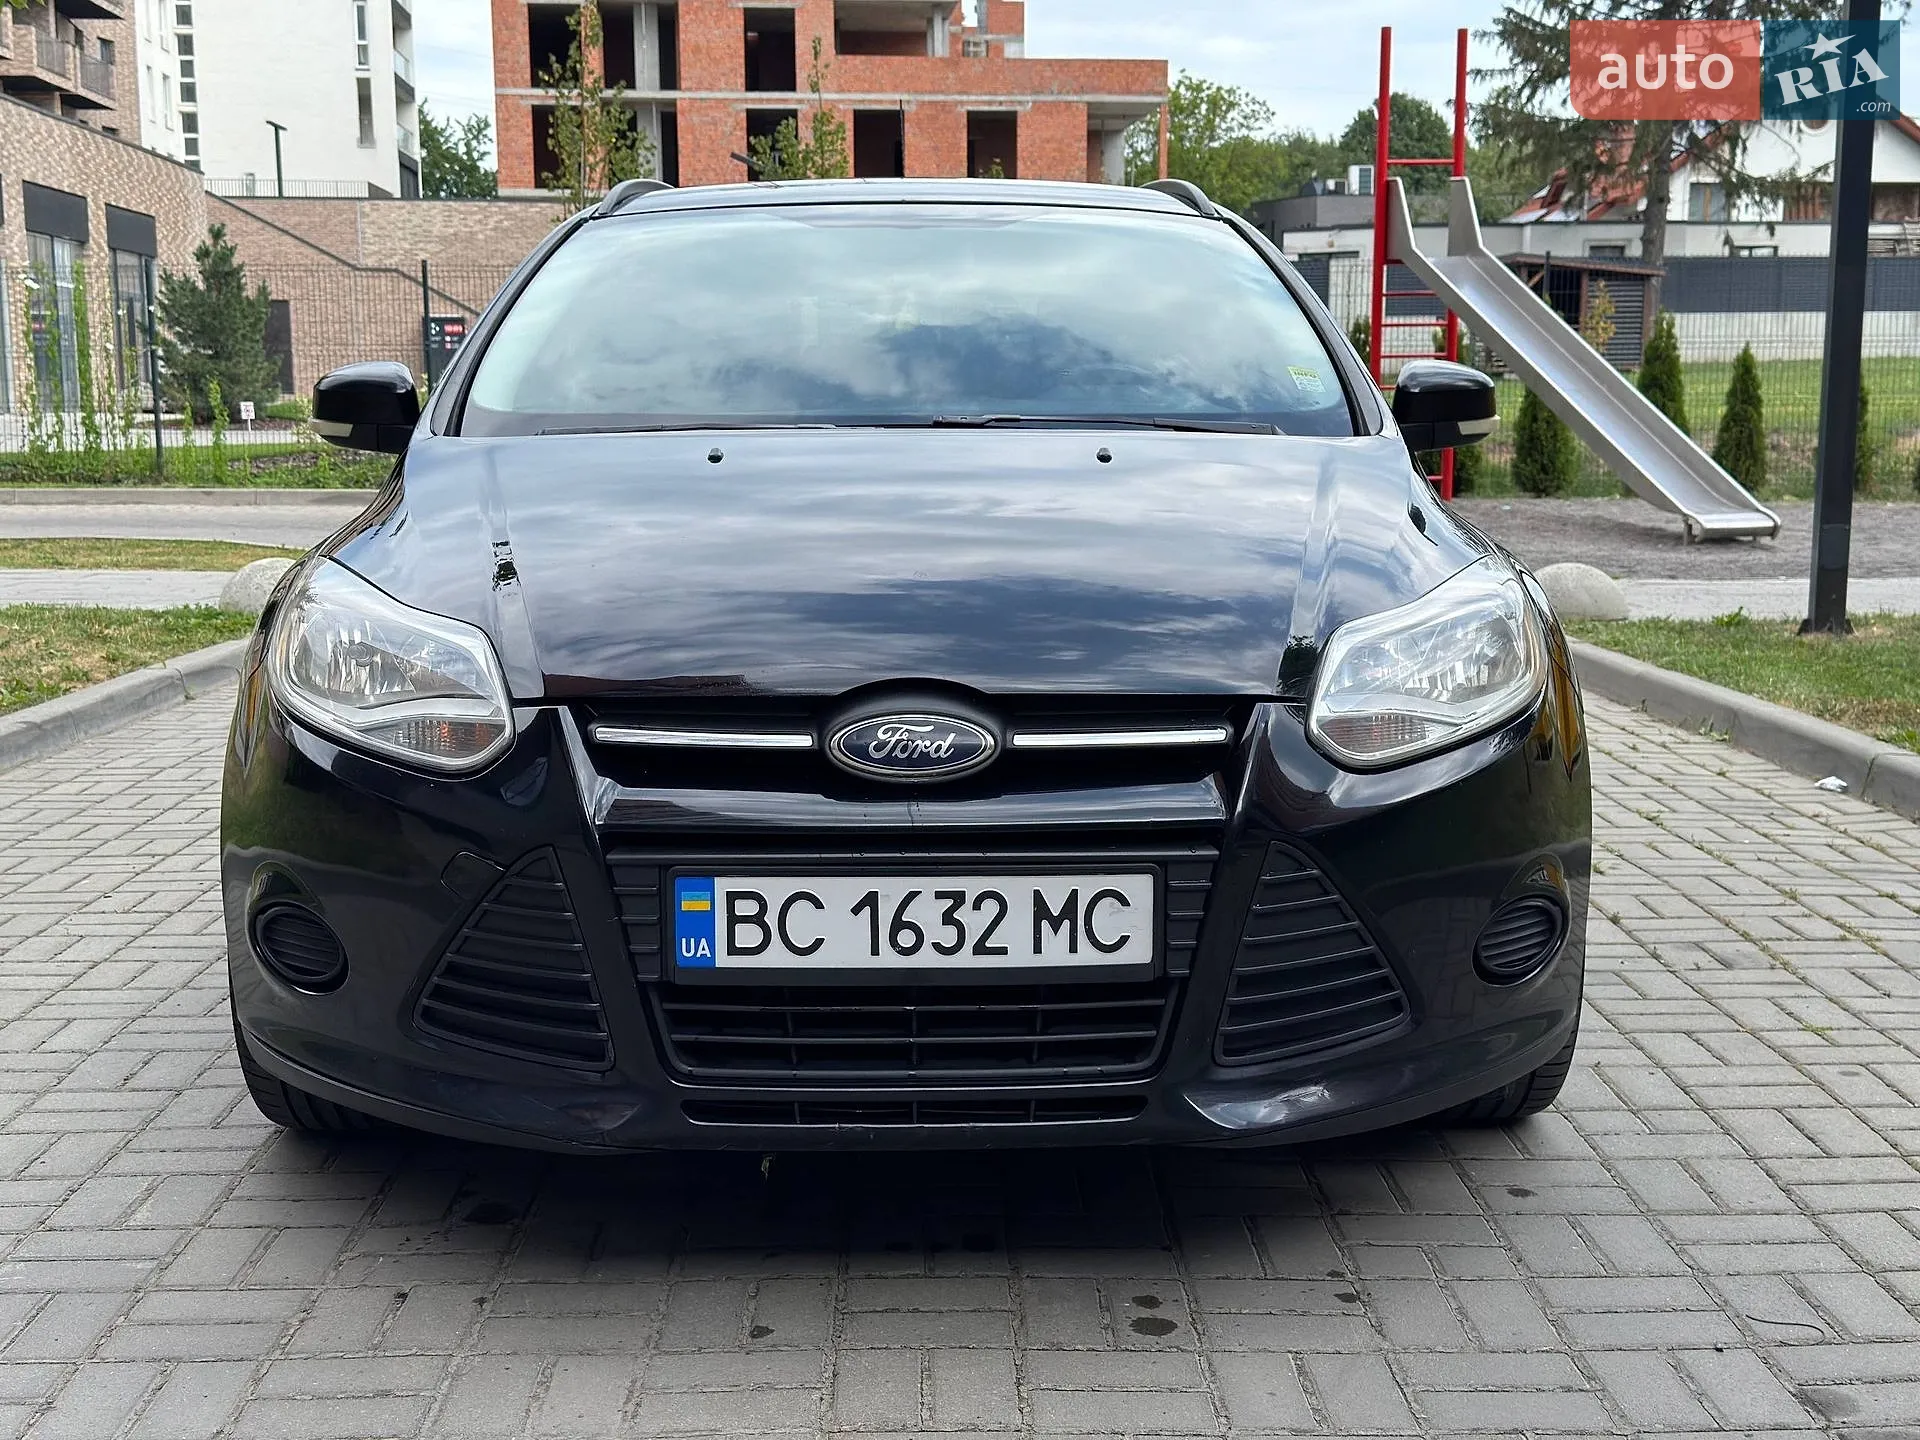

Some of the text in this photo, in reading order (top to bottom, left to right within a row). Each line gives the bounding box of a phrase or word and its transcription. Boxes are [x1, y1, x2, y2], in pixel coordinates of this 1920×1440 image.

[868, 723, 957, 759] Ford
[726, 888, 1131, 957] BC 1632 MC
[681, 938, 712, 958] UA
